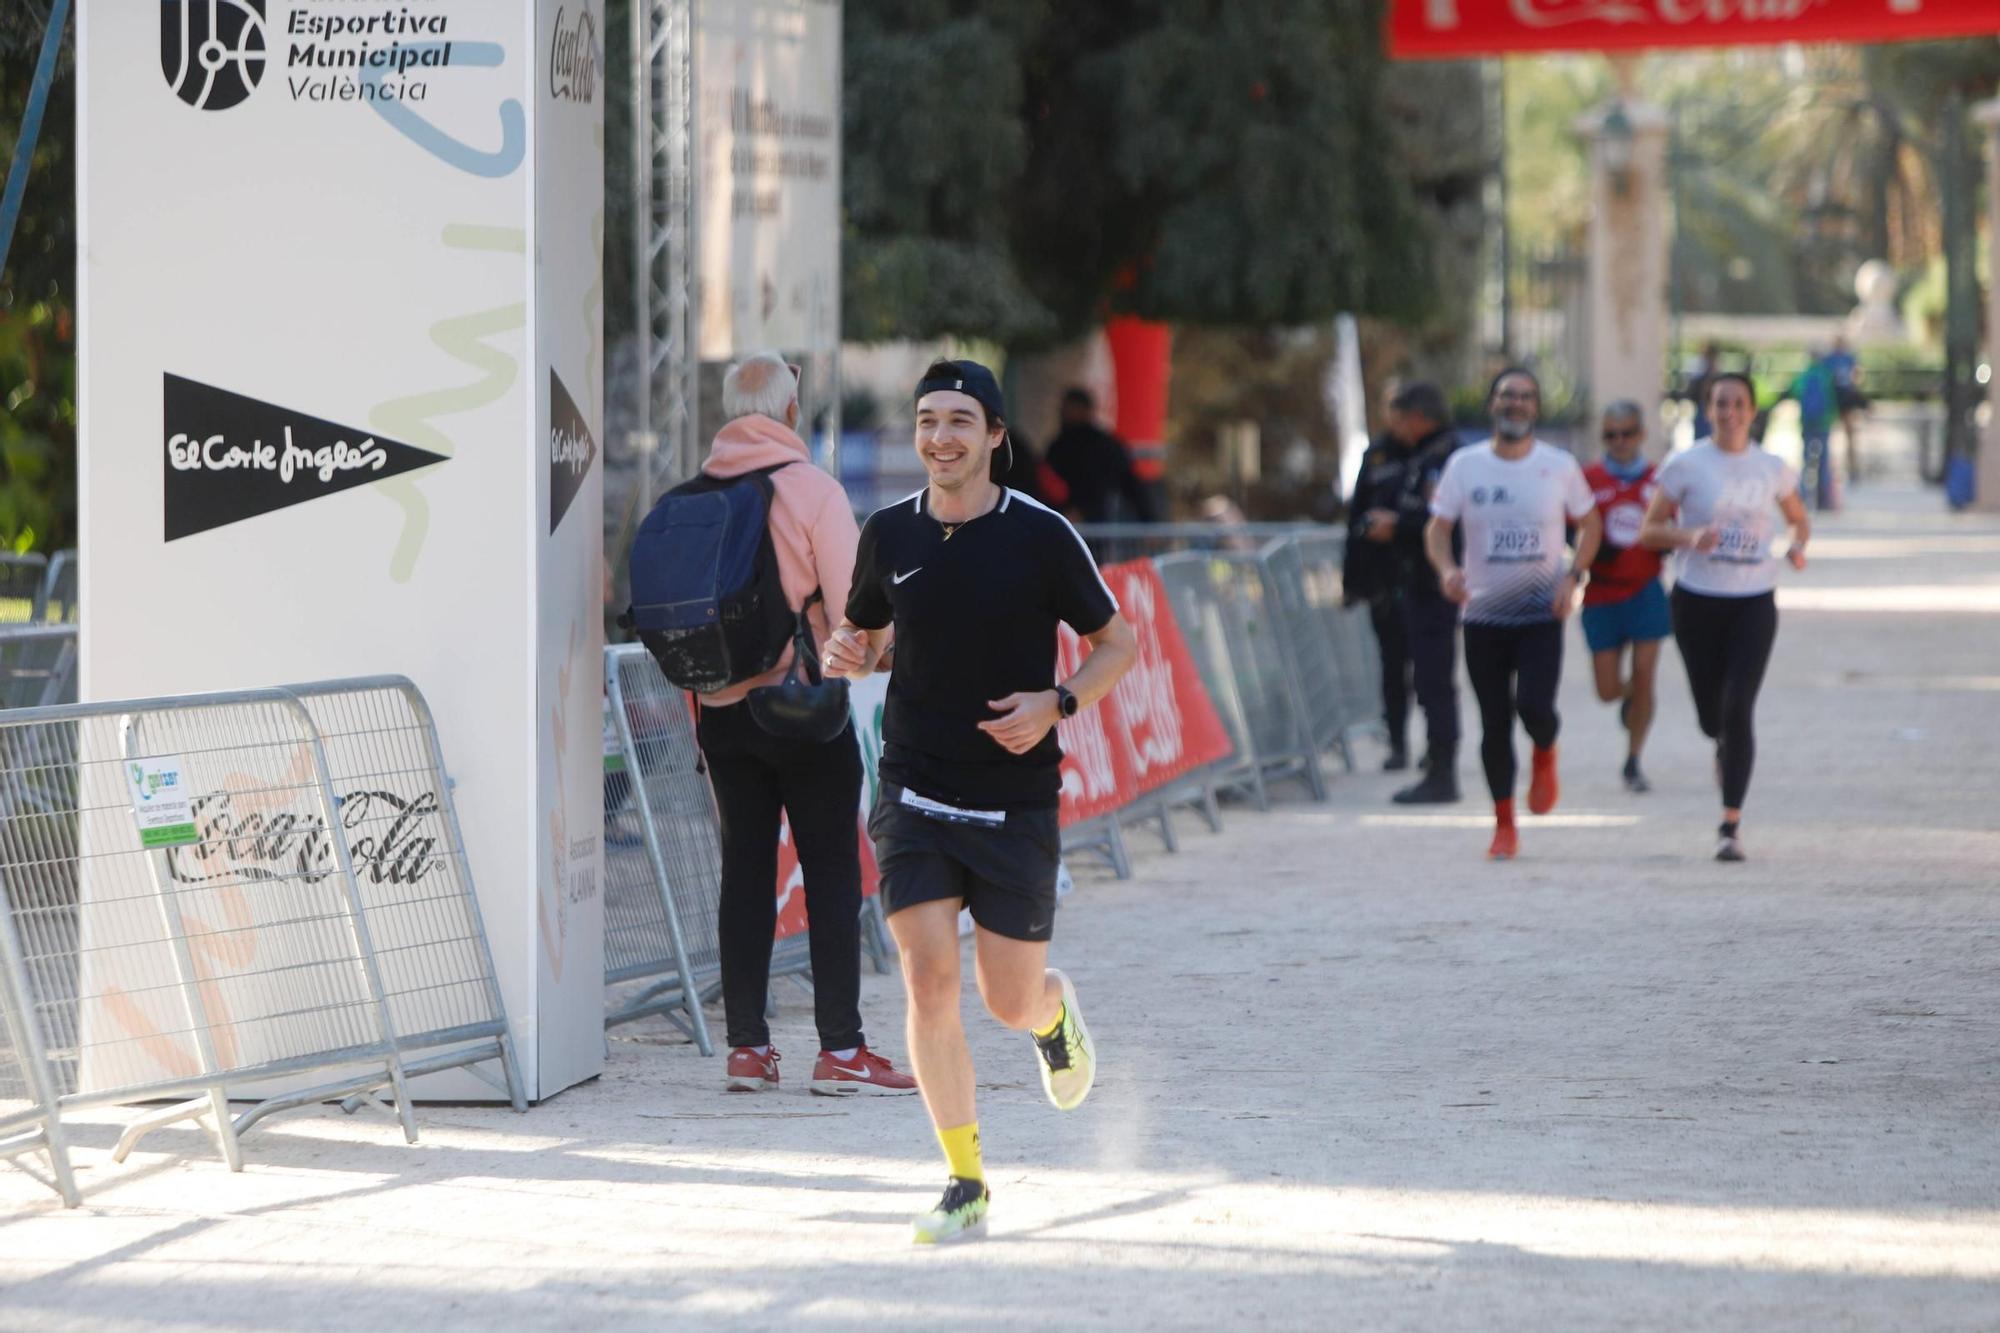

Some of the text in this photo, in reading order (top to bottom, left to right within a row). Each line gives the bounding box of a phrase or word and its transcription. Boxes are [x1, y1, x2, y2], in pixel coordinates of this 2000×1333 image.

[288, 8, 448, 41] Esportiva
[288, 41, 452, 74] Municipal
[288, 75, 427, 100] València
[168, 425, 387, 483] El Corte Inglés
[1494, 530, 1540, 552] 2023
